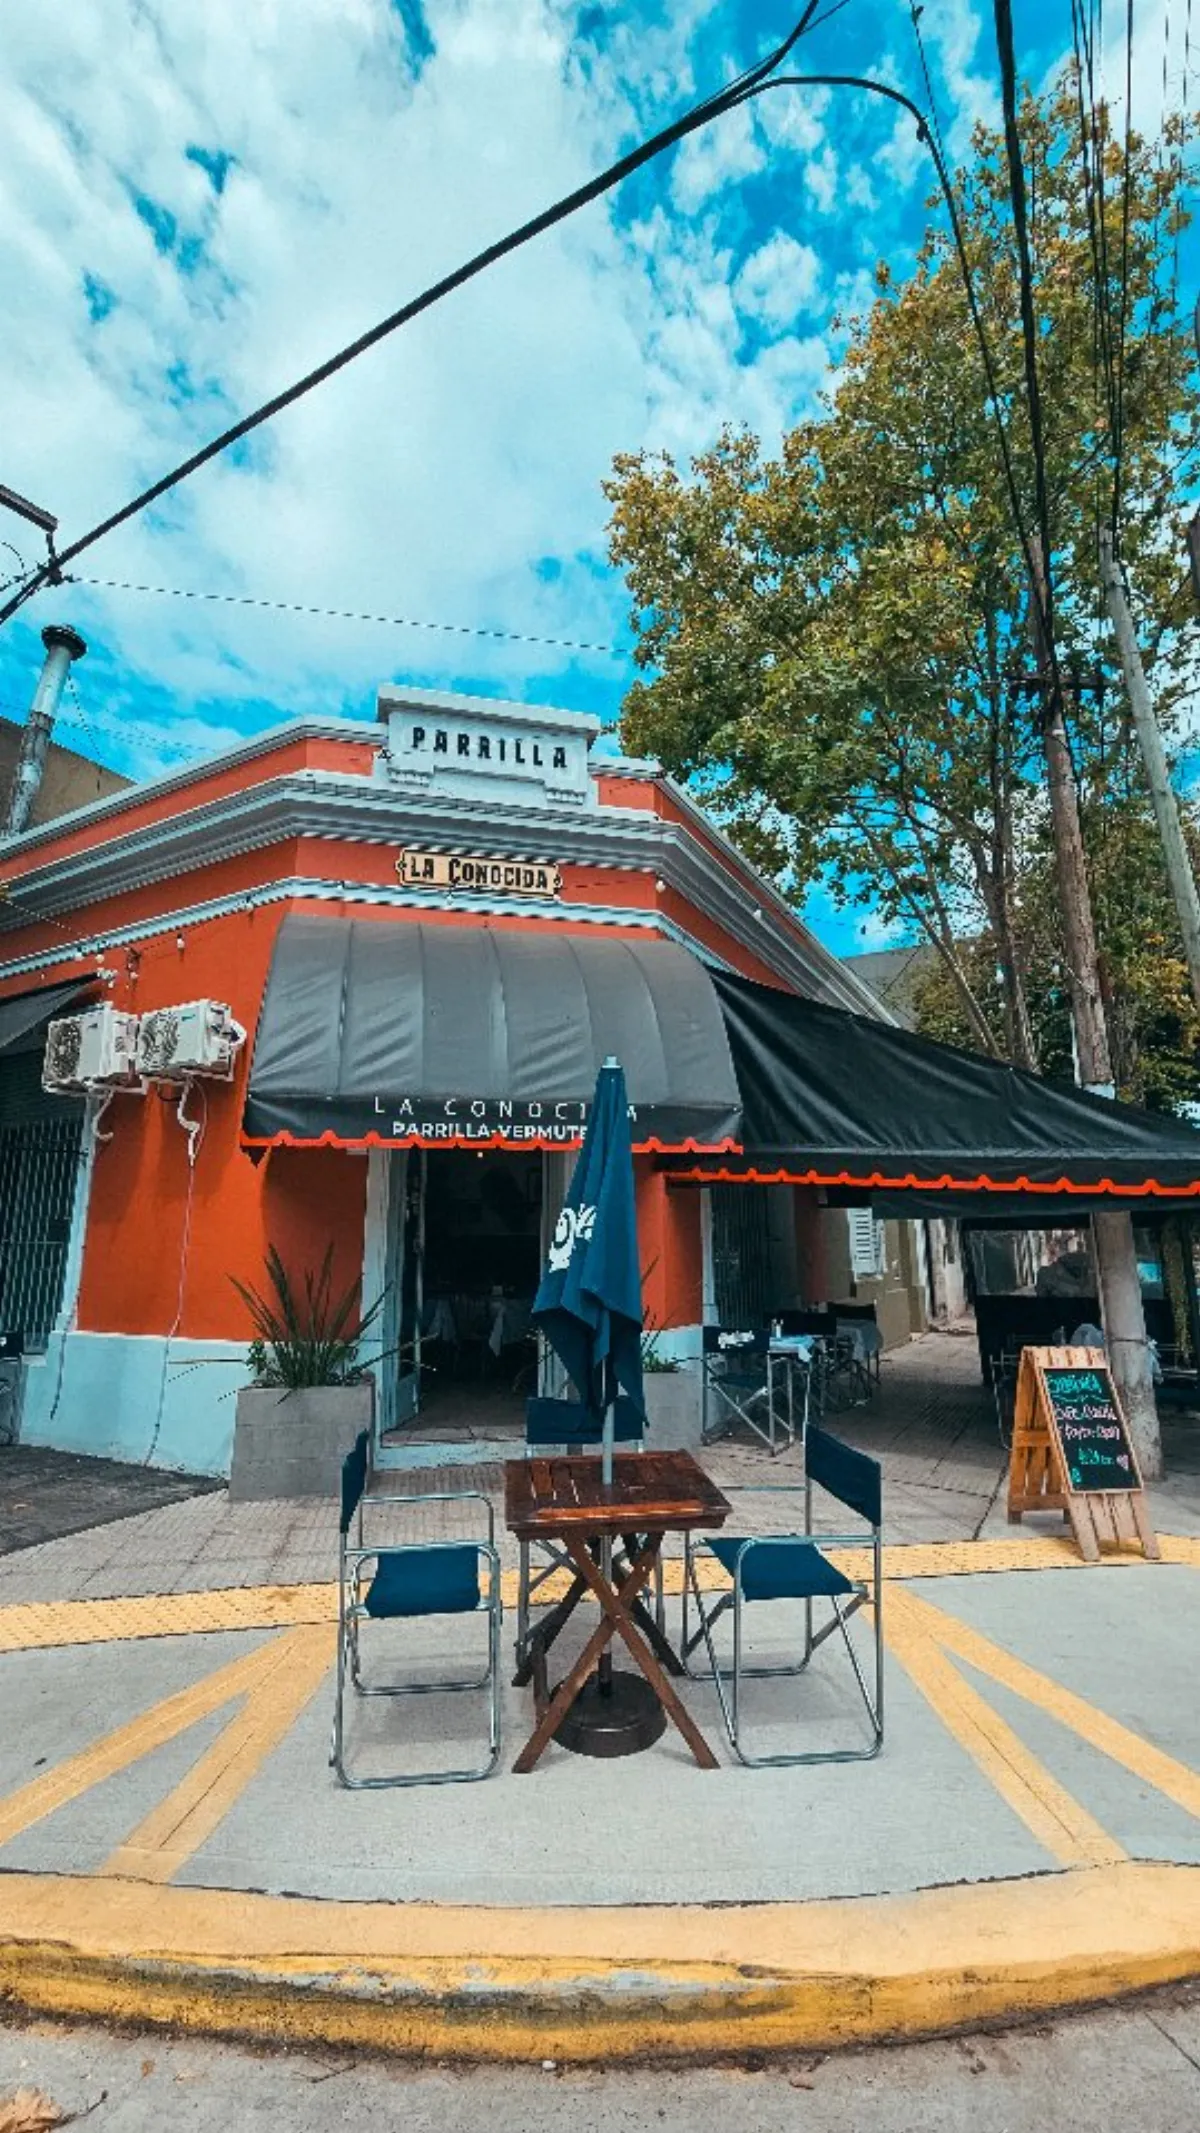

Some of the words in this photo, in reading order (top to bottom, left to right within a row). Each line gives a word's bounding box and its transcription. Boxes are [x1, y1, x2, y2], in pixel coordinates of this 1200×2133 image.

[412, 726, 567, 768] PARRILLA
[410, 856, 434, 878] LA
[448, 858, 548, 889] CONOCIDA
[374, 1096, 414, 1115] LA
[444, 1098, 637, 1122] CONOCIA
[393, 1120, 588, 1142] PARRILLA-VERMUTE
